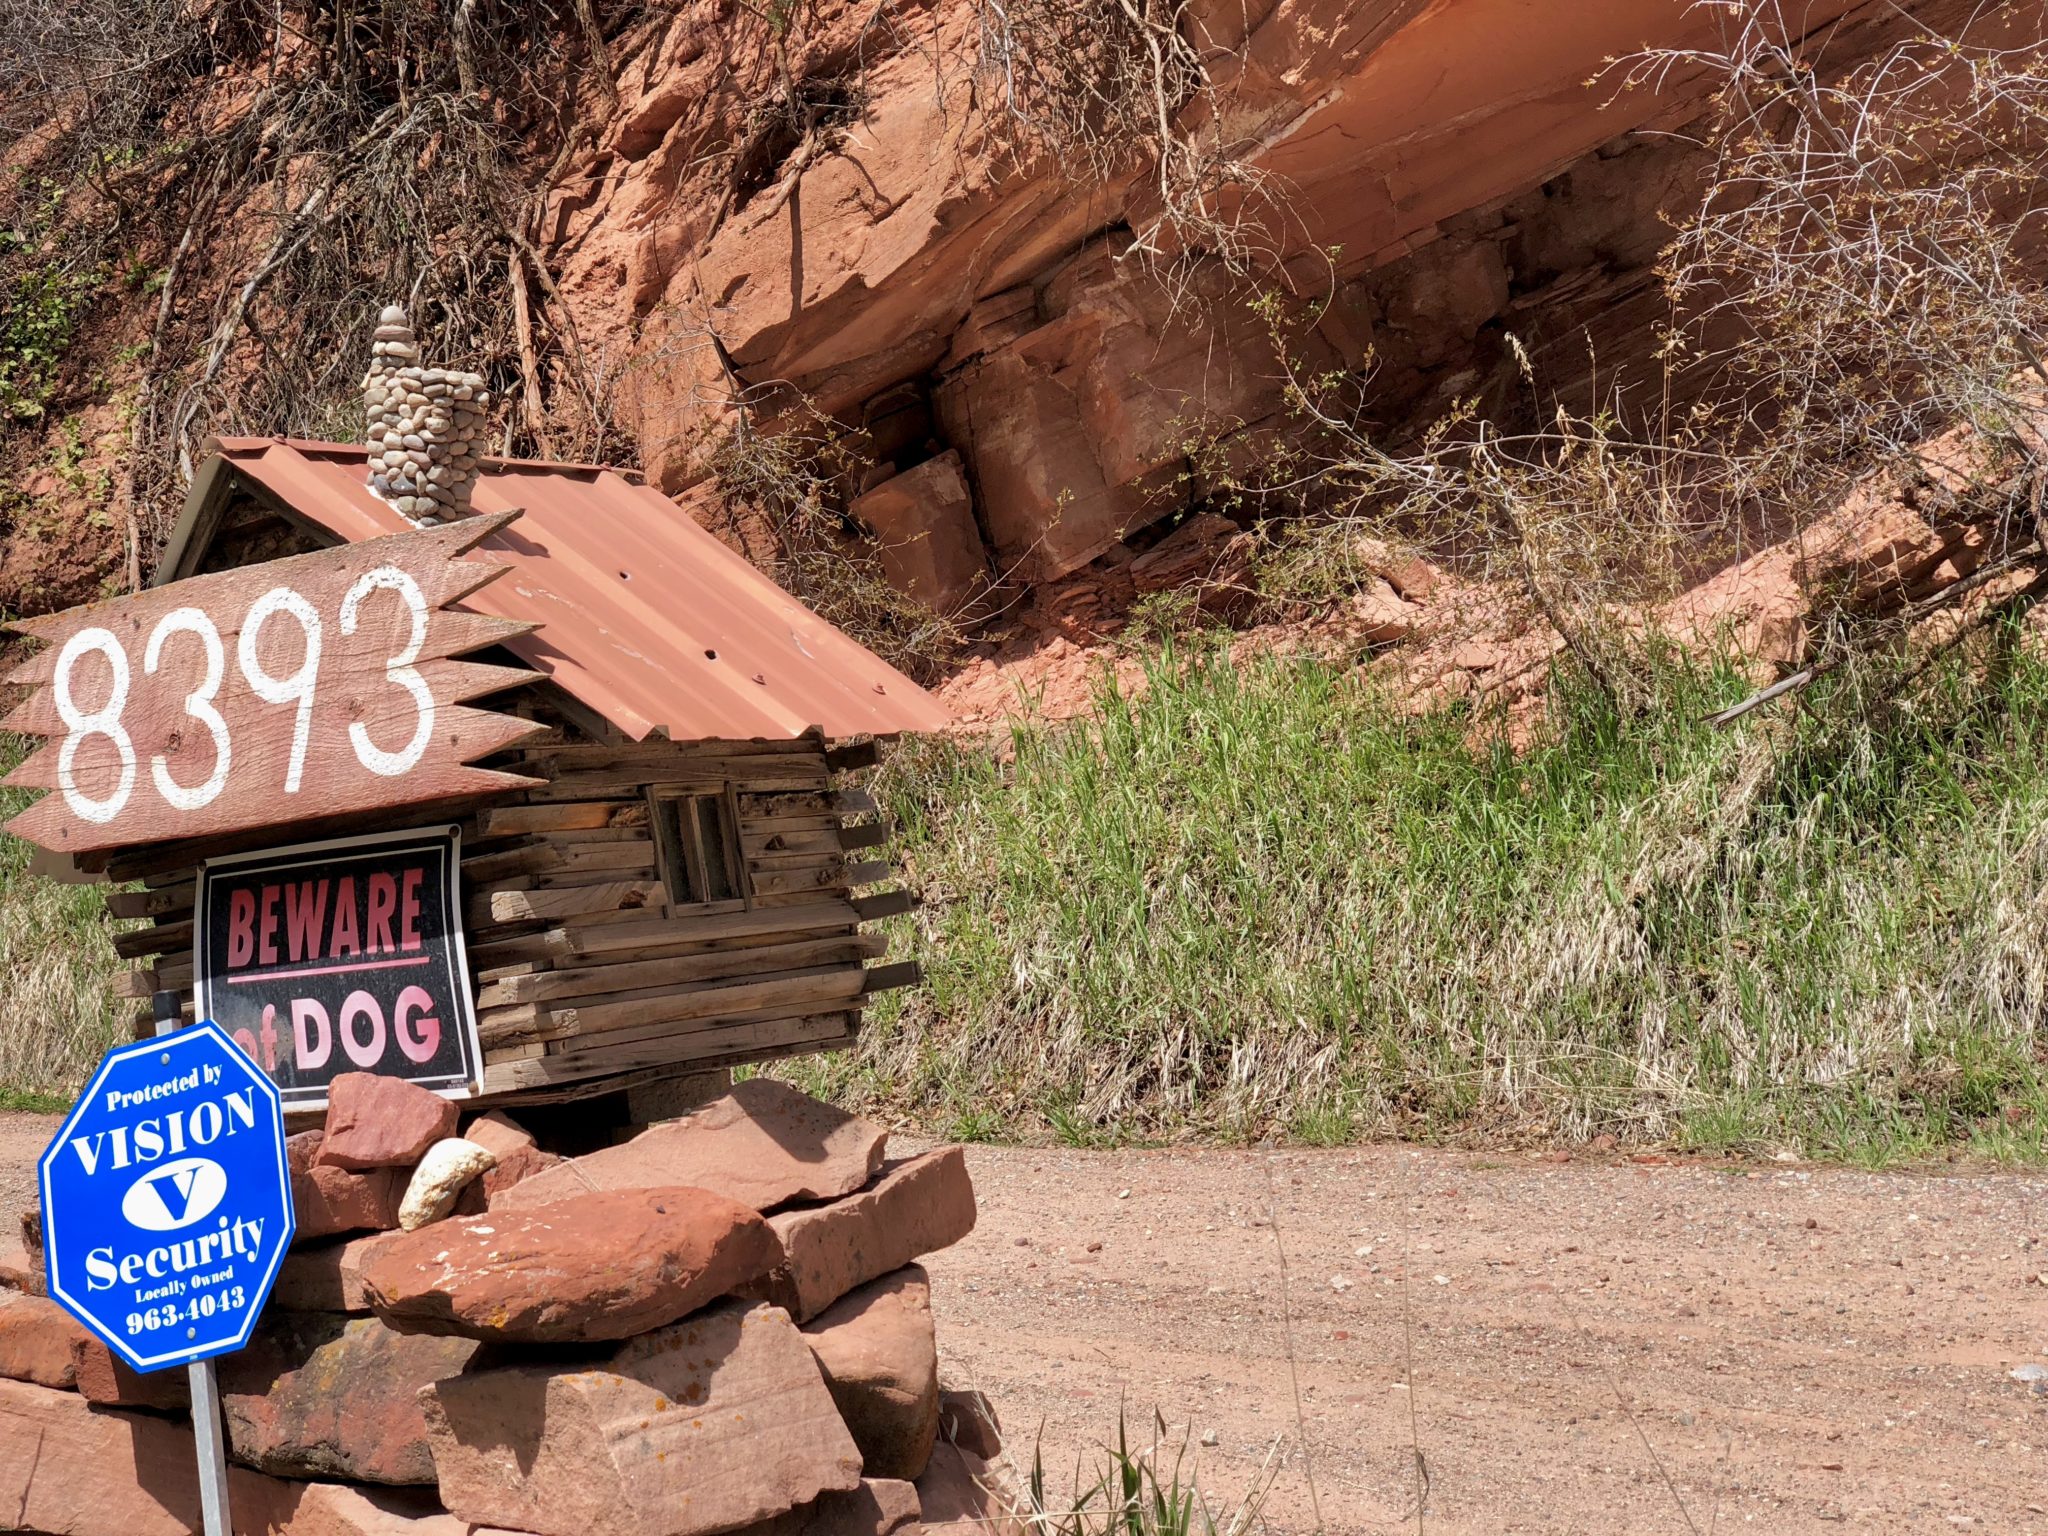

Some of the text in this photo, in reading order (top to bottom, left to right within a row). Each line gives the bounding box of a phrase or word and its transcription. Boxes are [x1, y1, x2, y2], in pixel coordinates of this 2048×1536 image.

[54, 565, 434, 824] 8393
[227, 867, 424, 968] BEWARE
[291, 985, 441, 1070] DOG
[106, 1063, 223, 1112] Protected by
[70, 1086, 255, 1176] VISION
[145, 1165, 205, 1221] V
[85, 1215, 265, 1292] Security
[135, 1265, 234, 1303] Locally Owned
